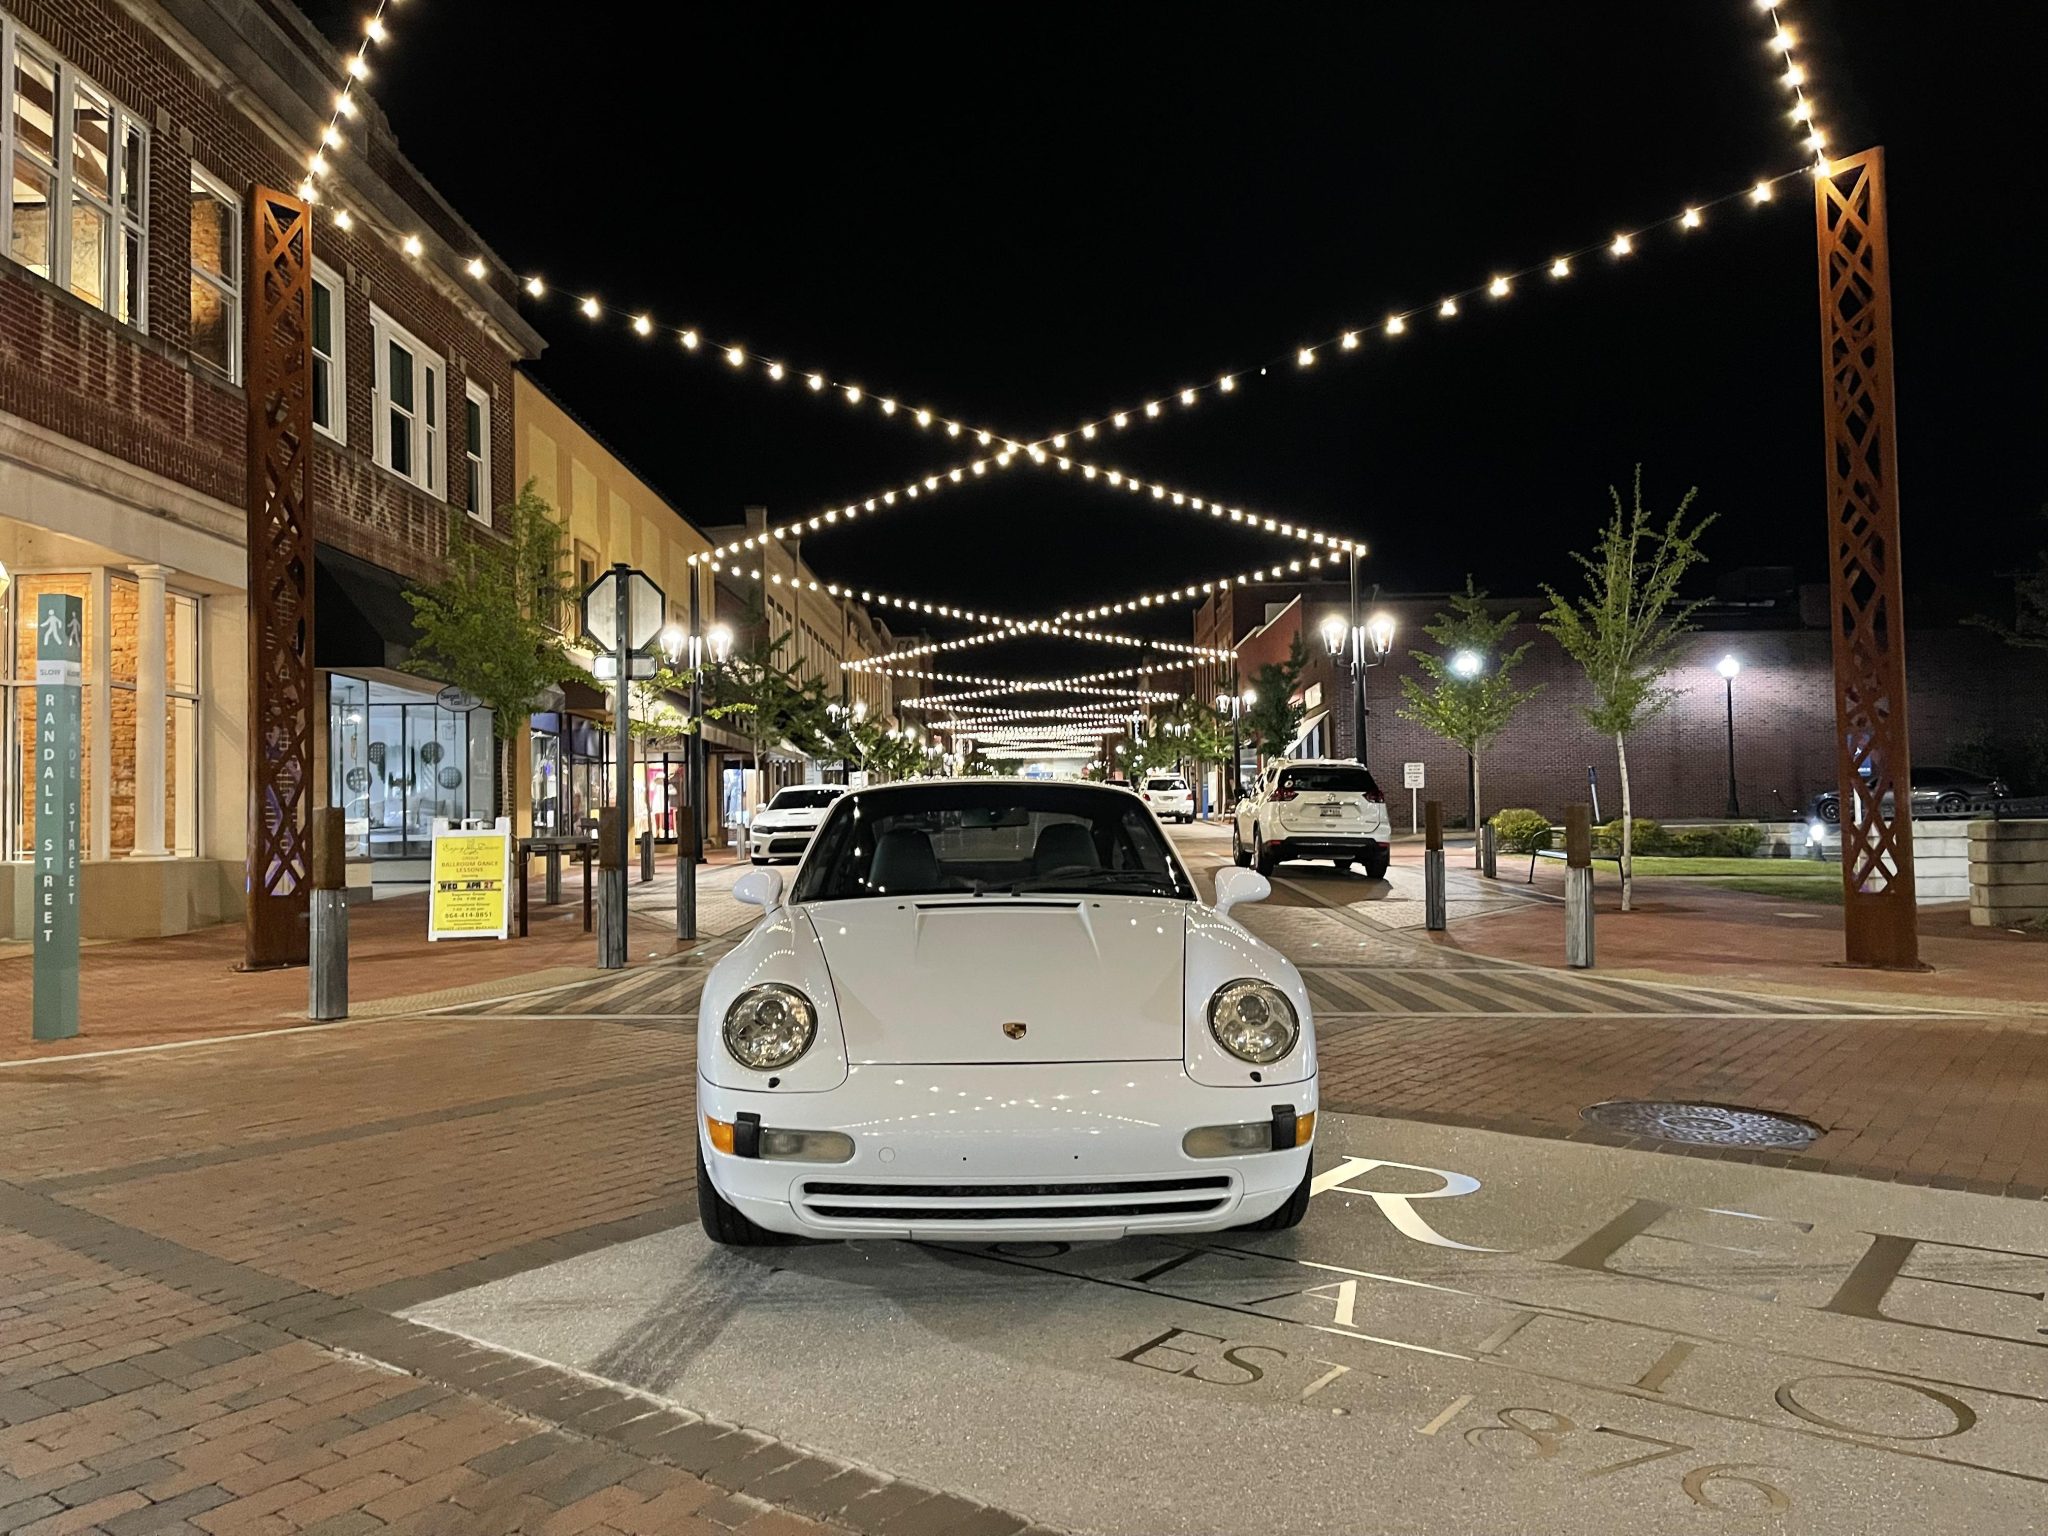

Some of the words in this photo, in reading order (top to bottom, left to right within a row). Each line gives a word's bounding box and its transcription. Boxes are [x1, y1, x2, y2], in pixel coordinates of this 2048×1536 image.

[44, 693, 55, 815] RANDALL
[68, 694, 77, 780] TRADE
[43, 838, 54, 943] STREET
[67, 803, 76, 905] STREET
[440, 882, 458, 890] WED
[466, 881, 481, 889] APR
[484, 881, 494, 889] 27
[1110, 1327, 1389, 1417] EST.
[1416, 1394, 1792, 1517] 1876
